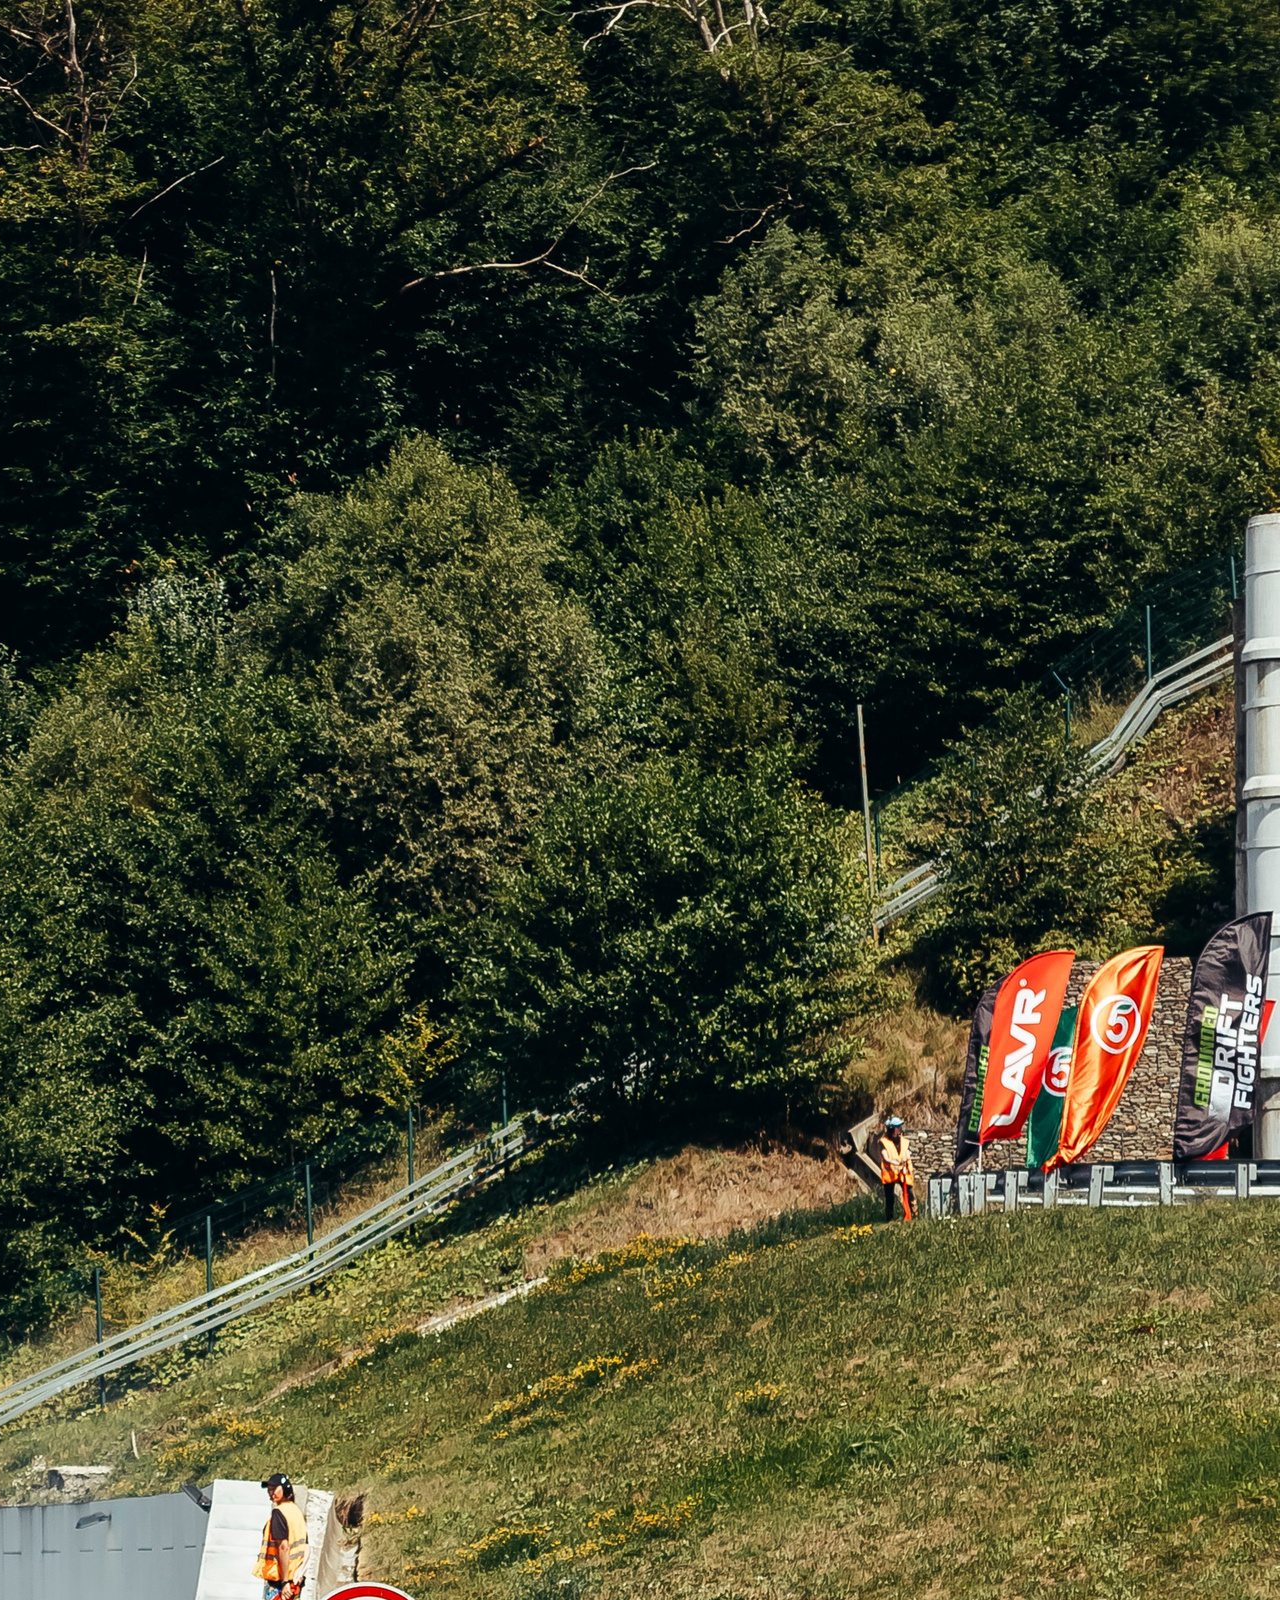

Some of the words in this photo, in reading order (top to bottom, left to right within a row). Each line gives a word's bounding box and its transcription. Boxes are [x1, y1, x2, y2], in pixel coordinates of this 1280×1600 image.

[989, 988, 1047, 1126] LAVR
[1105, 1001, 1134, 1043] 5
[1194, 1004, 1219, 1108] GROUNDED
[1208, 993, 1243, 1124] DRIFT
[1234, 973, 1263, 1110] FIGHTERS
